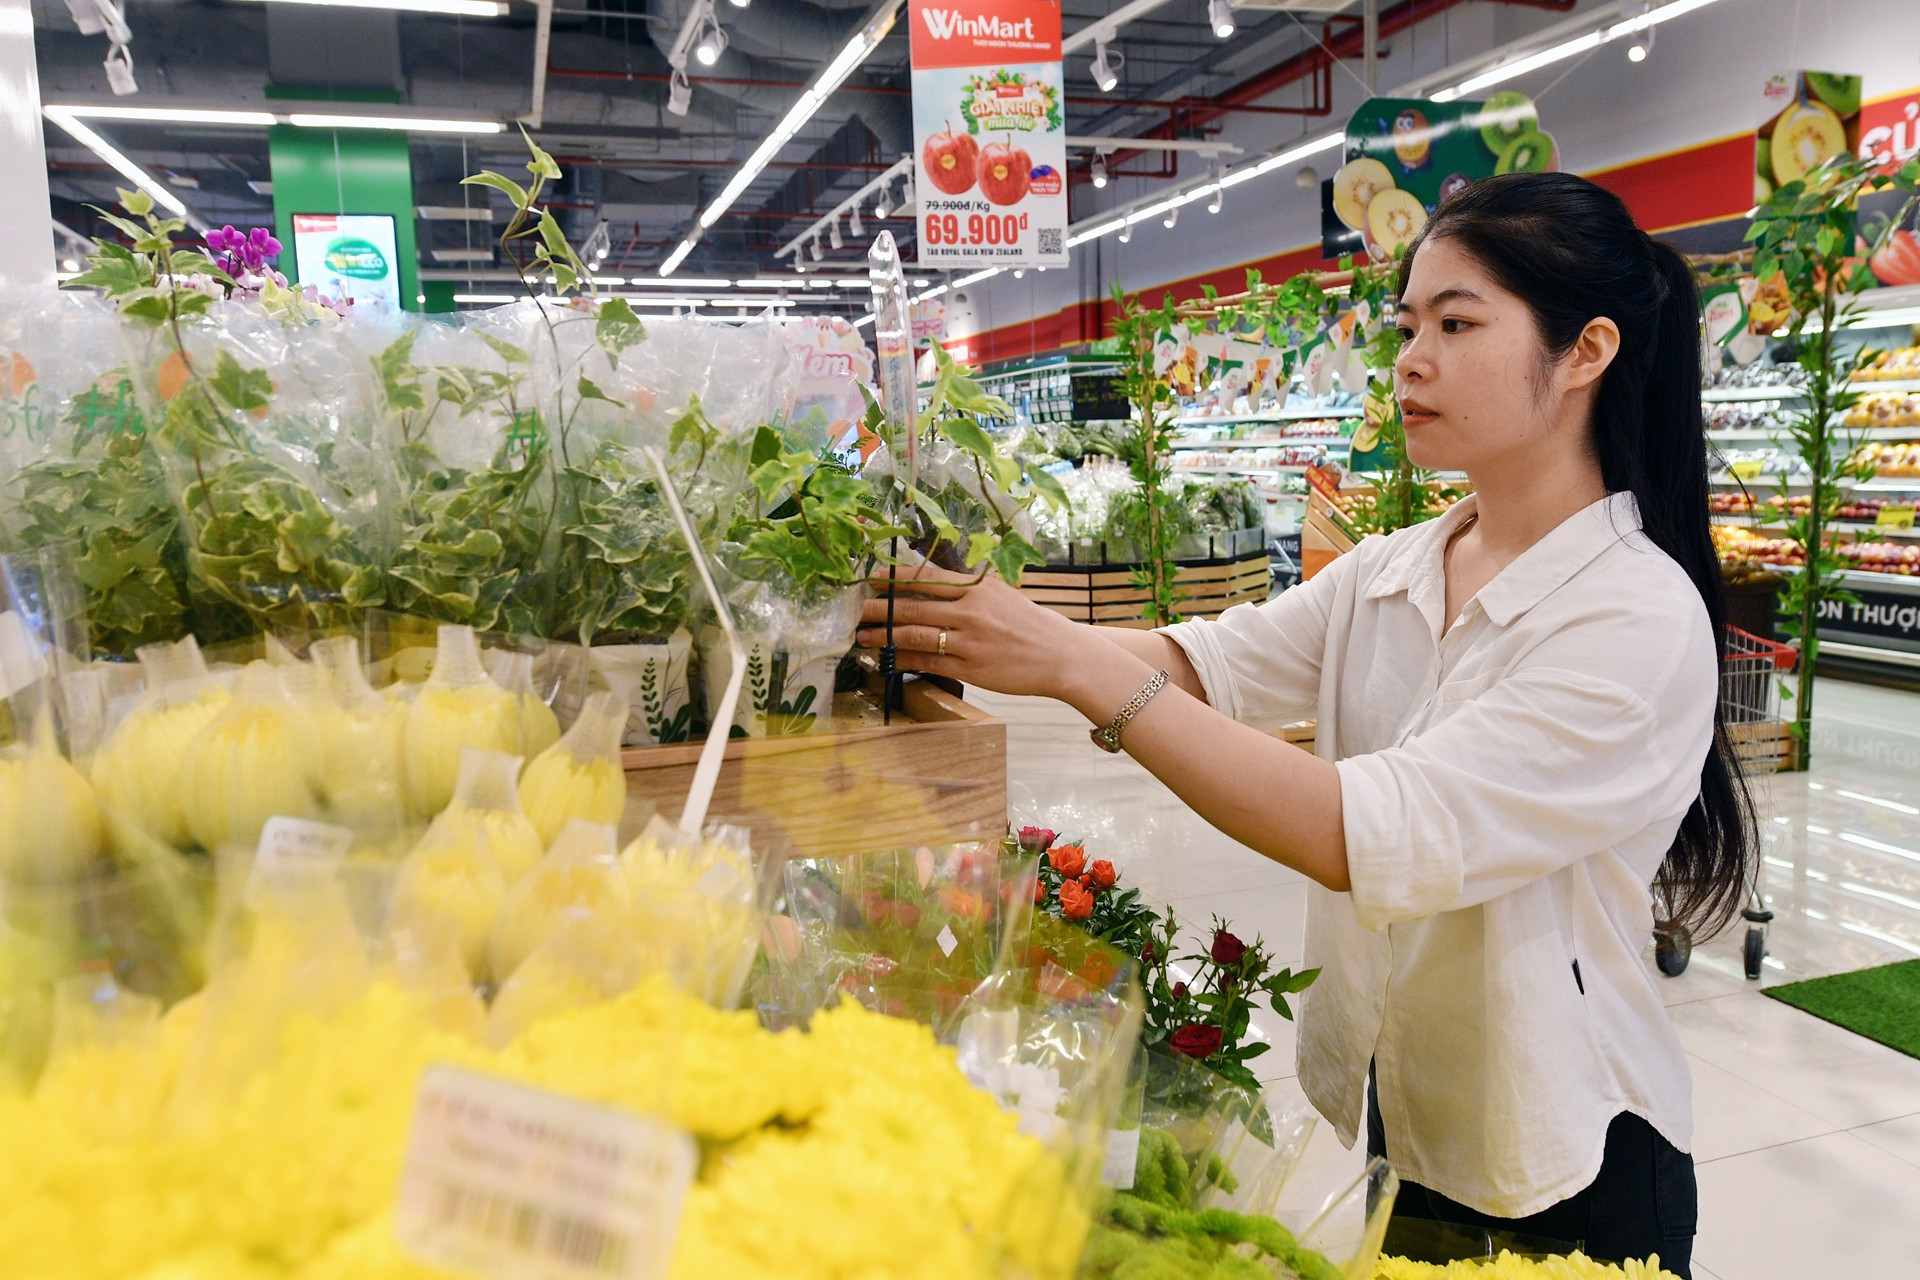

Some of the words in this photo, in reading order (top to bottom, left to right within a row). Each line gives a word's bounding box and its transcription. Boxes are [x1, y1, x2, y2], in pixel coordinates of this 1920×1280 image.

[921, 7, 1035, 40] WinMart
[941, 248, 961, 256] ROYAL
[980, 248, 994, 256] NEW
[996, 248, 1023, 256] ZEALAND
[1850, 603, 1920, 633] THƯỢ
